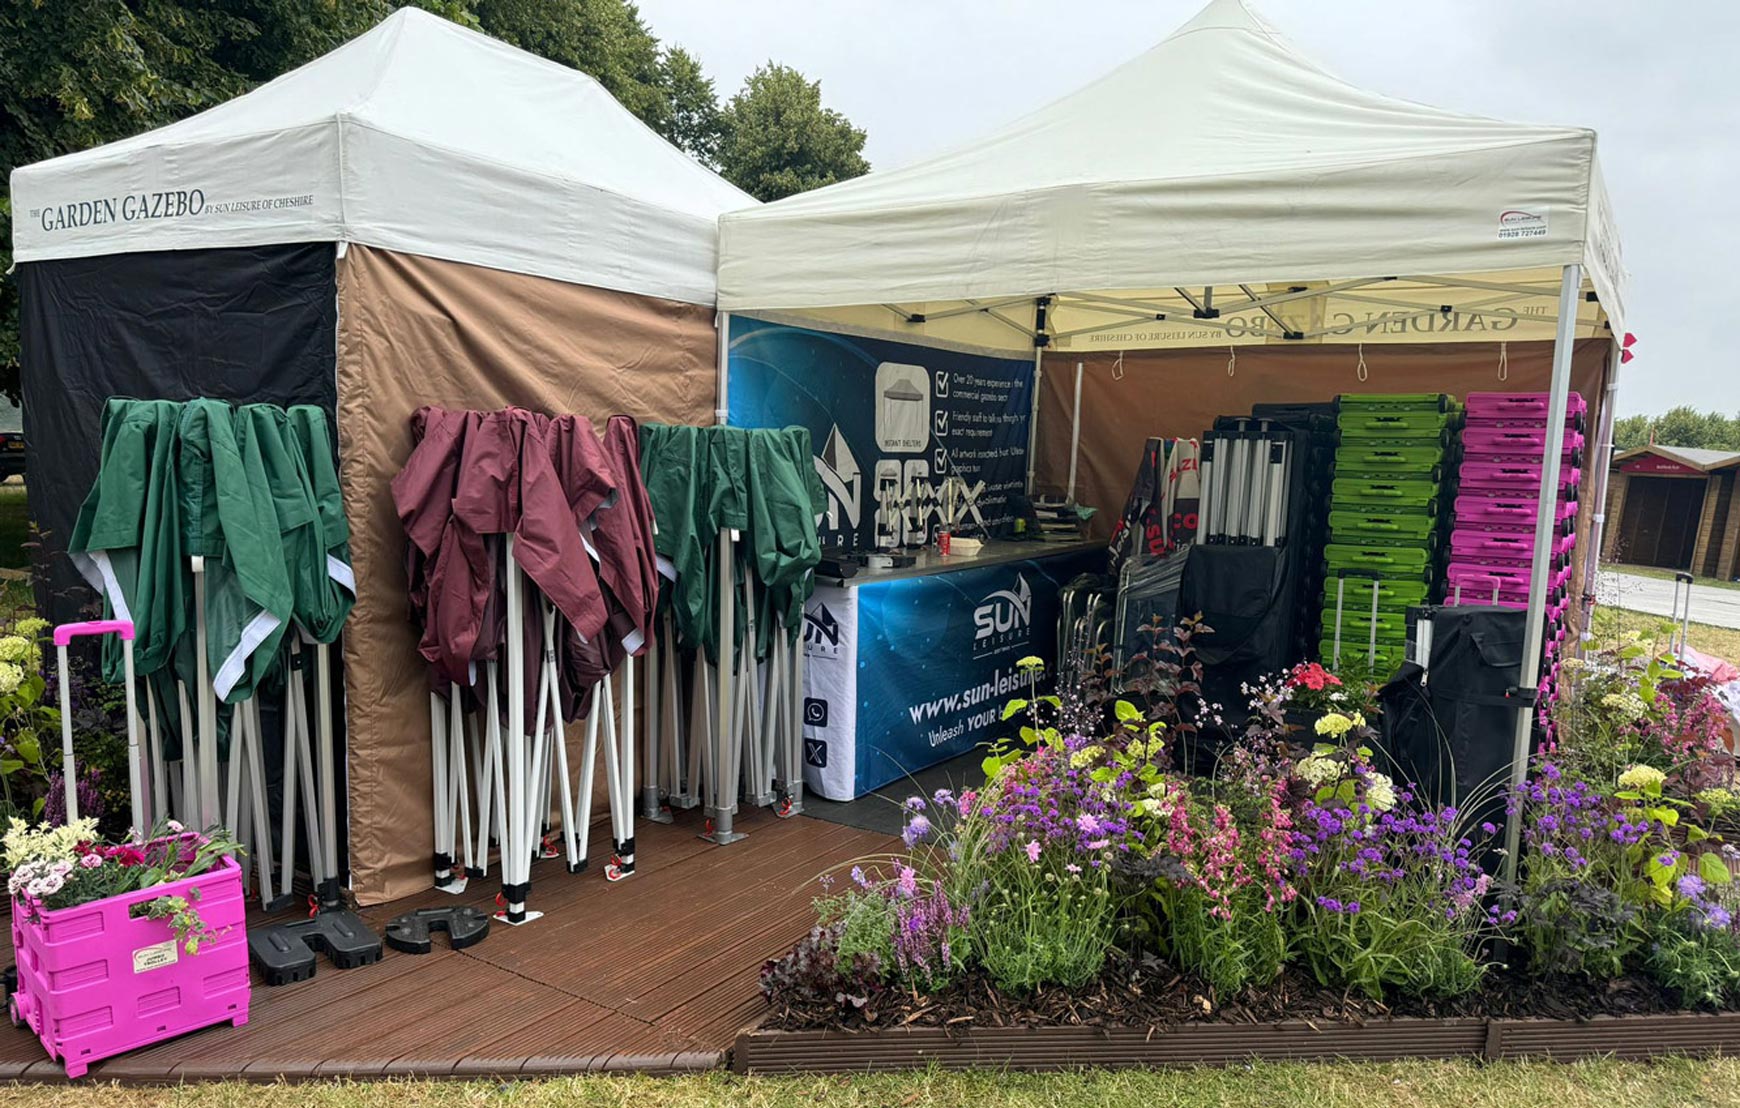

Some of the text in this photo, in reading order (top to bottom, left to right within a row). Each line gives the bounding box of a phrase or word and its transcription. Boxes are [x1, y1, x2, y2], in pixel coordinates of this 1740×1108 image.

[30, 189, 314, 231] THE GARDEN GAZEBO BY SUN LEISURE OF CHESHIRE
[973, 589, 1032, 640] SUN
[973, 627, 1030, 651] LEISURE
[928, 708, 996, 747] Unleash YOUR
